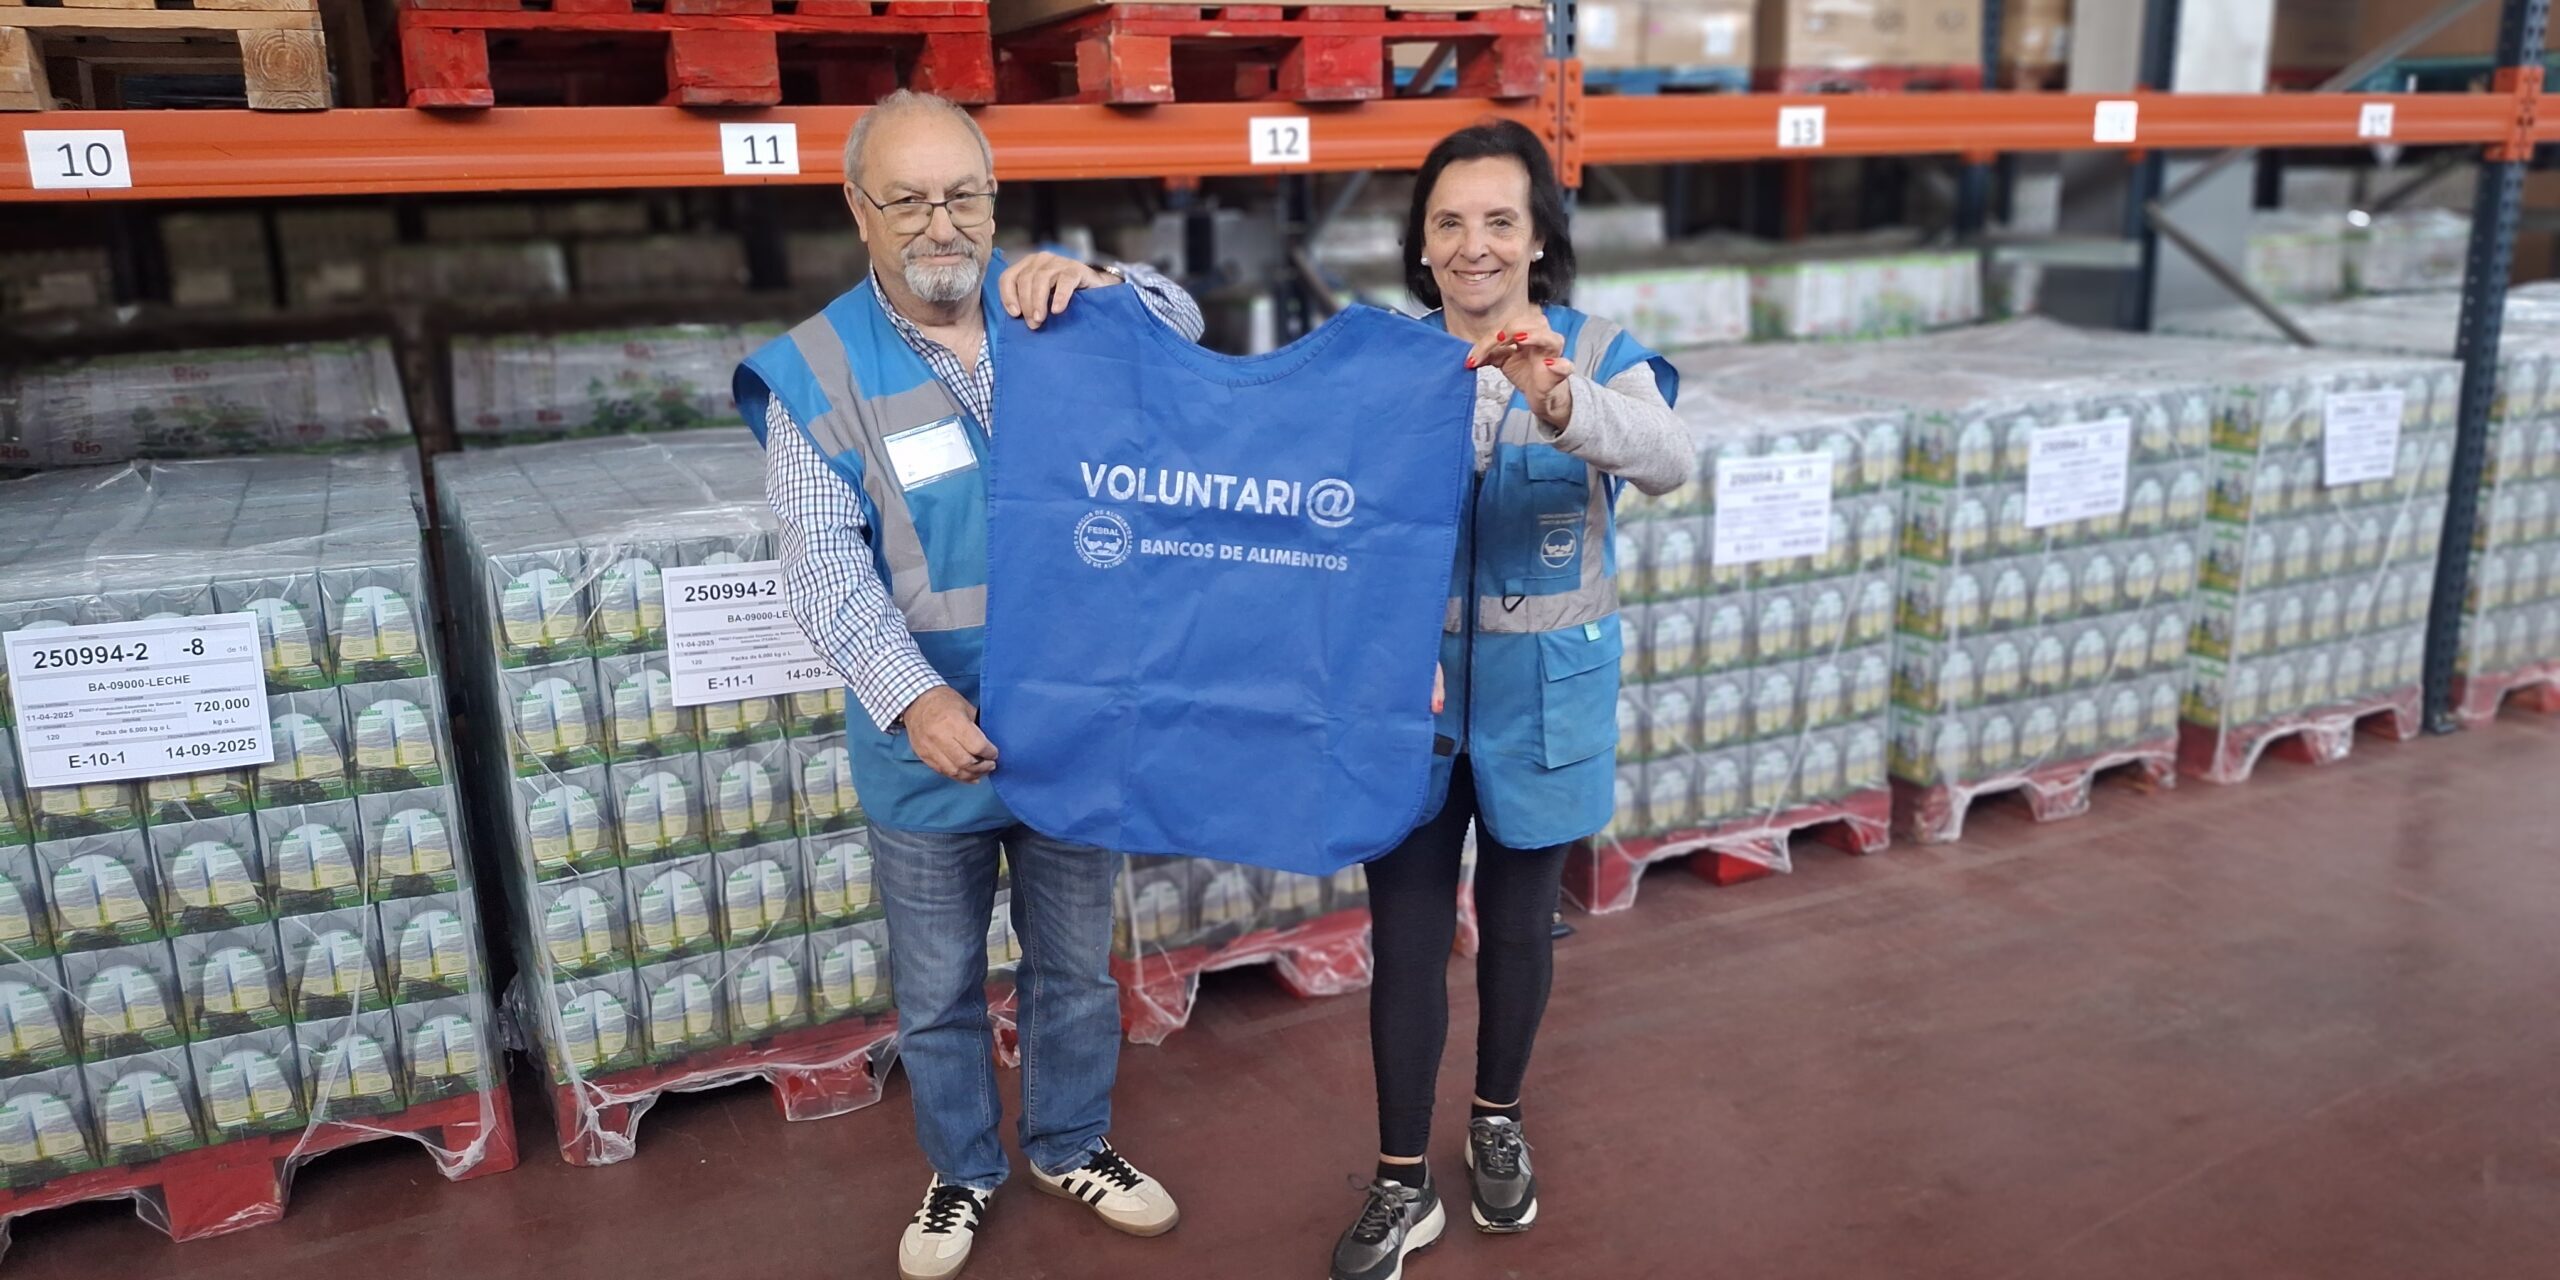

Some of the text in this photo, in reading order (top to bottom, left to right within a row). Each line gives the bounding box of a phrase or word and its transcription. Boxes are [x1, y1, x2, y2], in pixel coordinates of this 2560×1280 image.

[1267, 126, 1301, 155] 12
[1792, 117, 1817, 144] 13
[57, 142, 112, 176] 10
[743, 134, 785, 165] 11
[1080, 461, 1355, 528] VOLUNTARI@
[1140, 538, 1348, 572] BANCOS DE ALIMENTOS
[684, 579, 777, 603] 250994-2
[727, 609, 791, 623] BA-09000-LE
[33, 638, 204, 669] 250994-2 -8
[88, 674, 191, 692] BA-09000-LECHE
[708, 673, 755, 690] E-11-1
[785, 666, 834, 681] 14-09-2
[26, 710, 74, 722] 11-04-2025
[194, 697, 250, 713] 720,000
[68, 750, 126, 769] E-10-1
[165, 737, 257, 759] 14-09-2025
